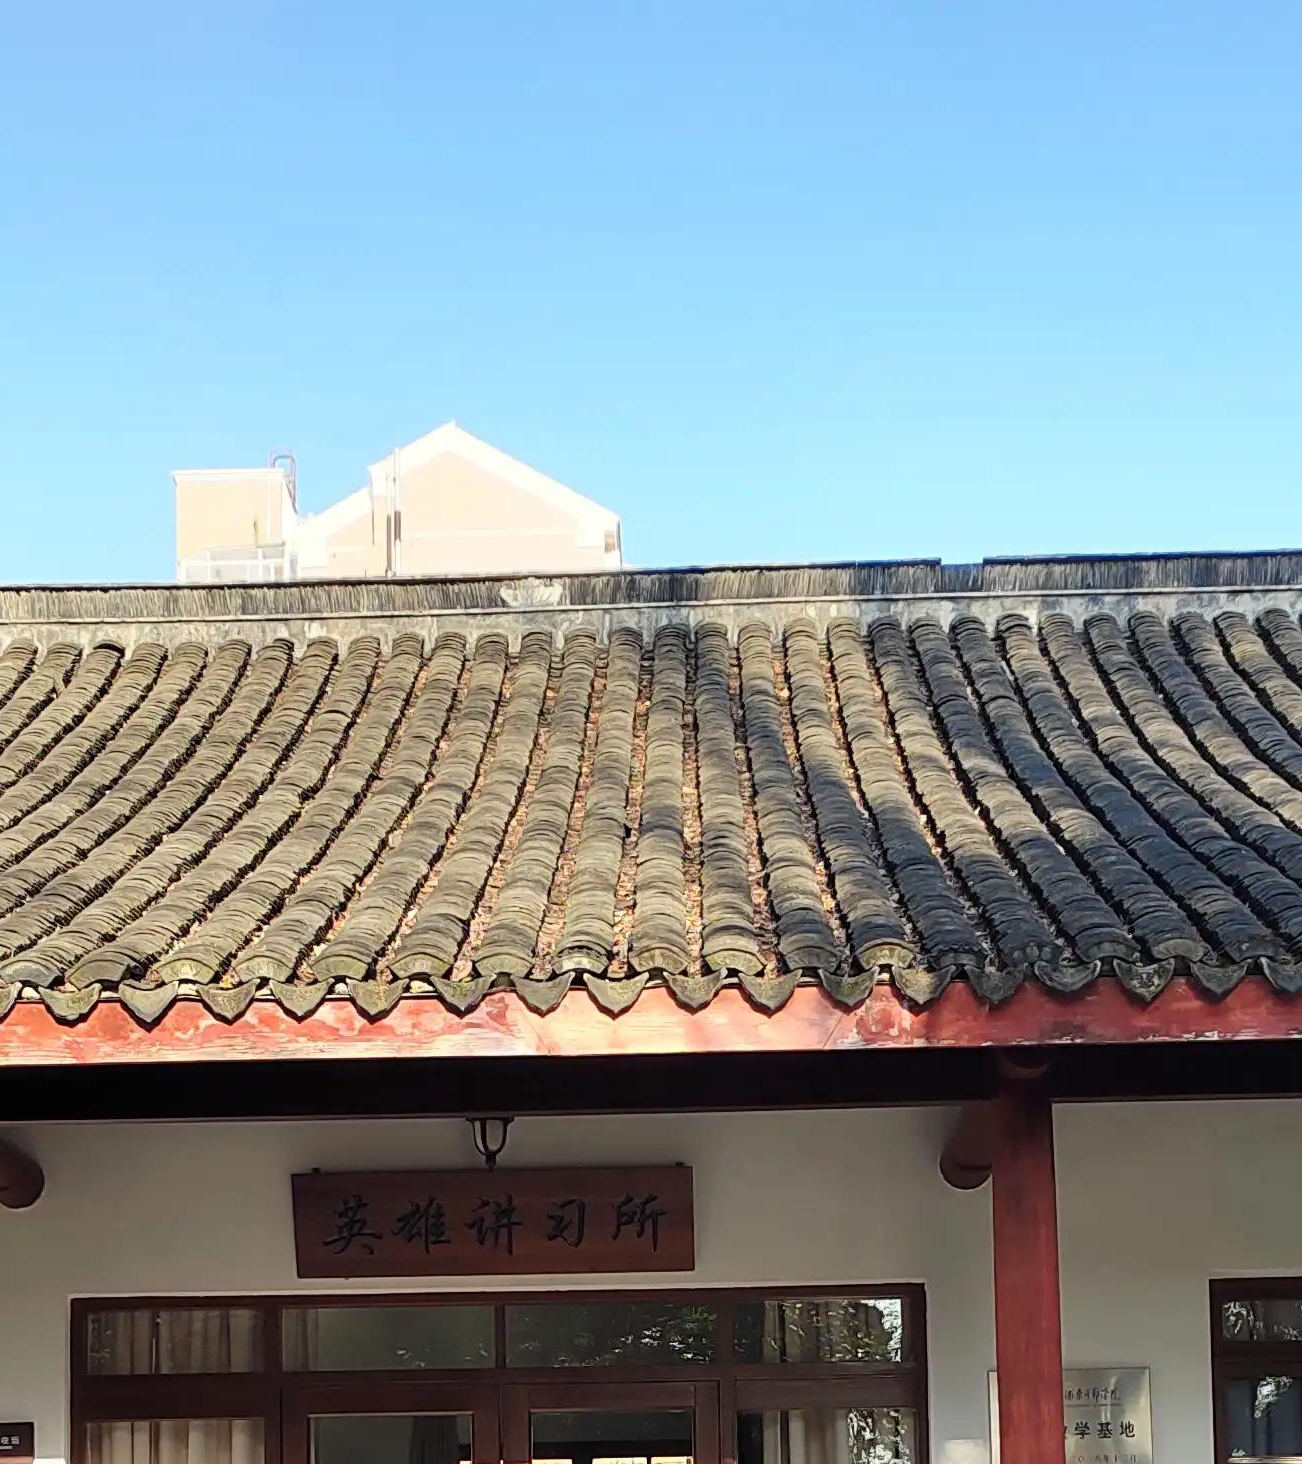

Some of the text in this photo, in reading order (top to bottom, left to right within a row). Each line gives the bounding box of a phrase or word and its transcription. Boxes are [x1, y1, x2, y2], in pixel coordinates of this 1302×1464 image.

[322, 1193, 667, 1256] 英雄讲习所
